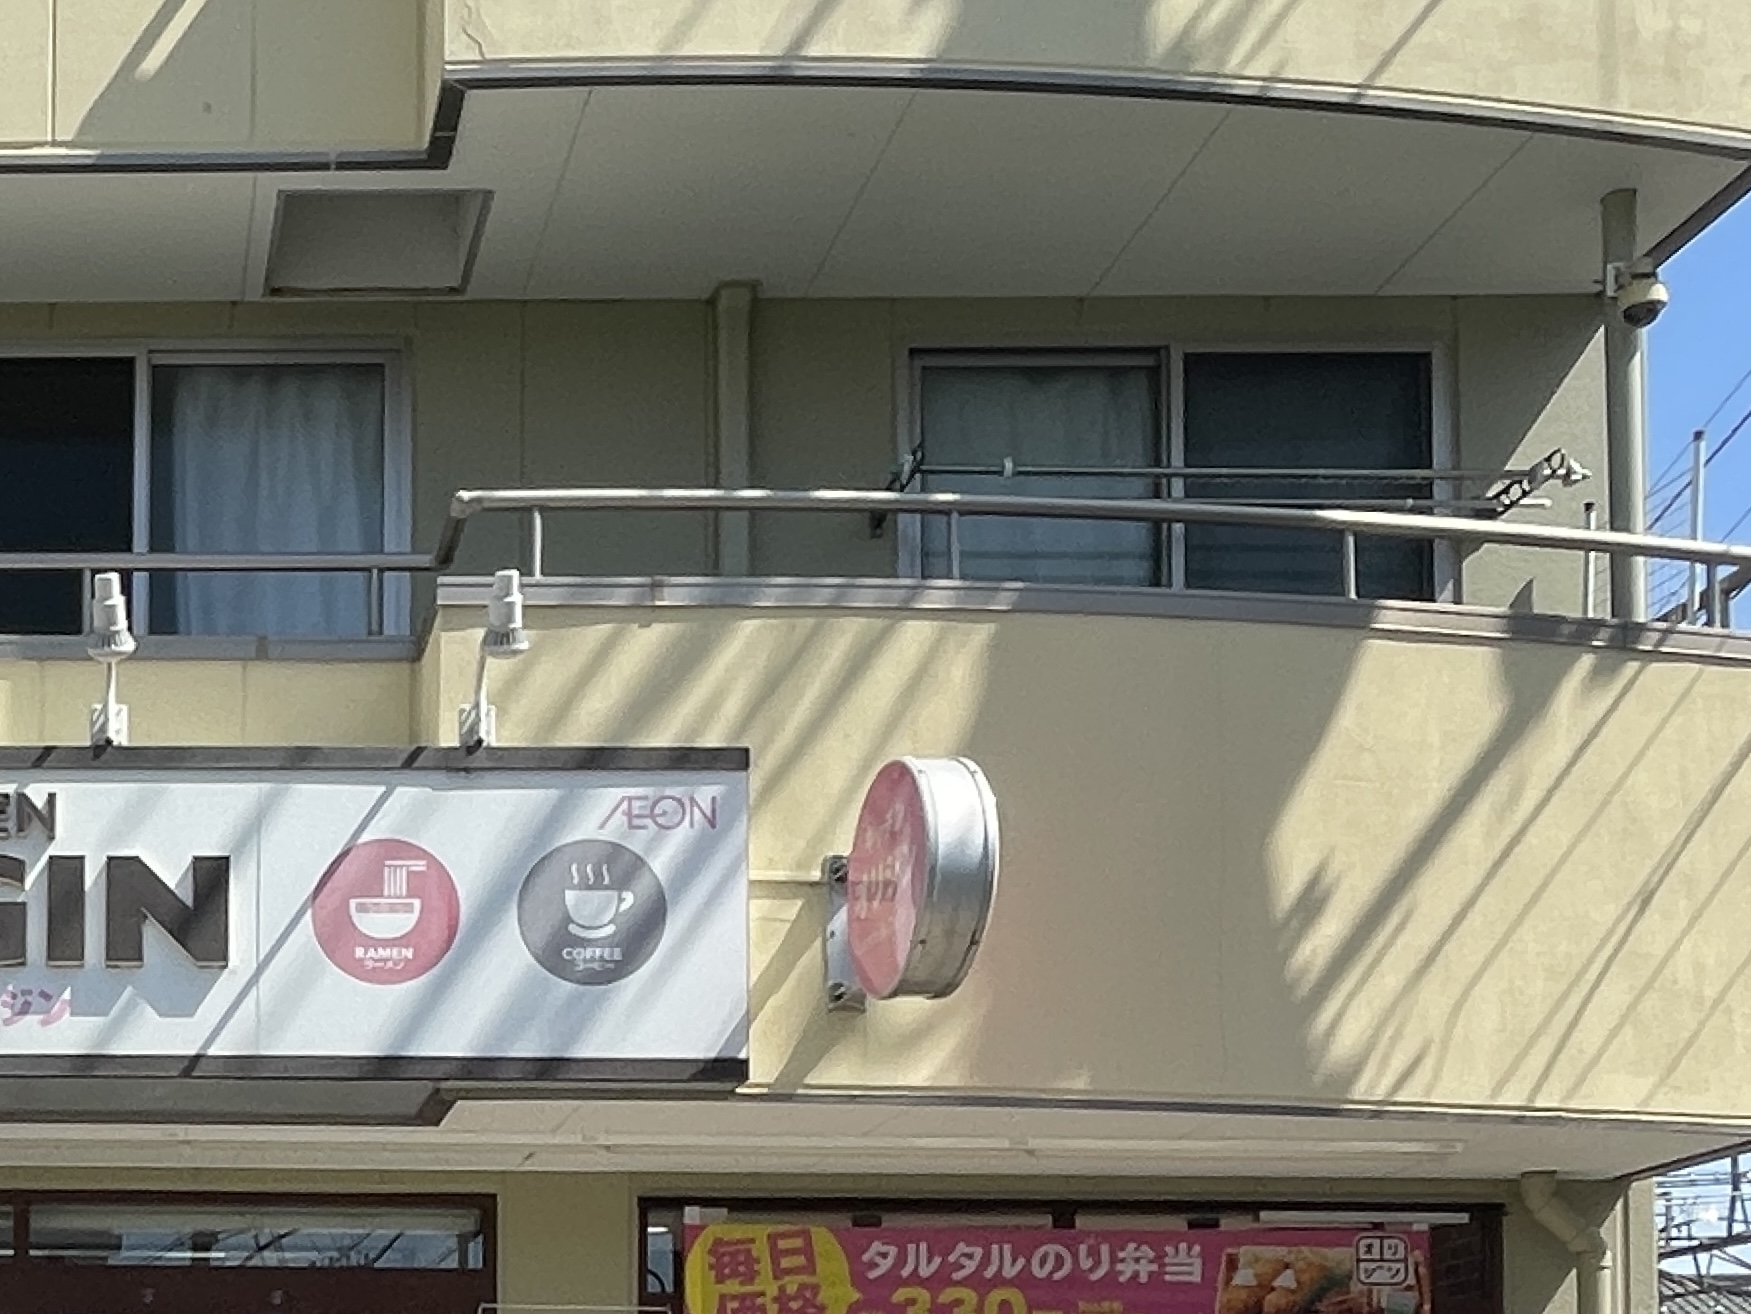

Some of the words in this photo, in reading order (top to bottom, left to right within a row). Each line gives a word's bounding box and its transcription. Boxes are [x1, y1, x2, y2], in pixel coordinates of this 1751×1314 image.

[354, 946, 414, 959] RAMEN
[561, 947, 623, 960] COFFEE
[708, 1227, 818, 1286] 毎日
[861, 1241, 1204, 1284] タルタルのり弁当
